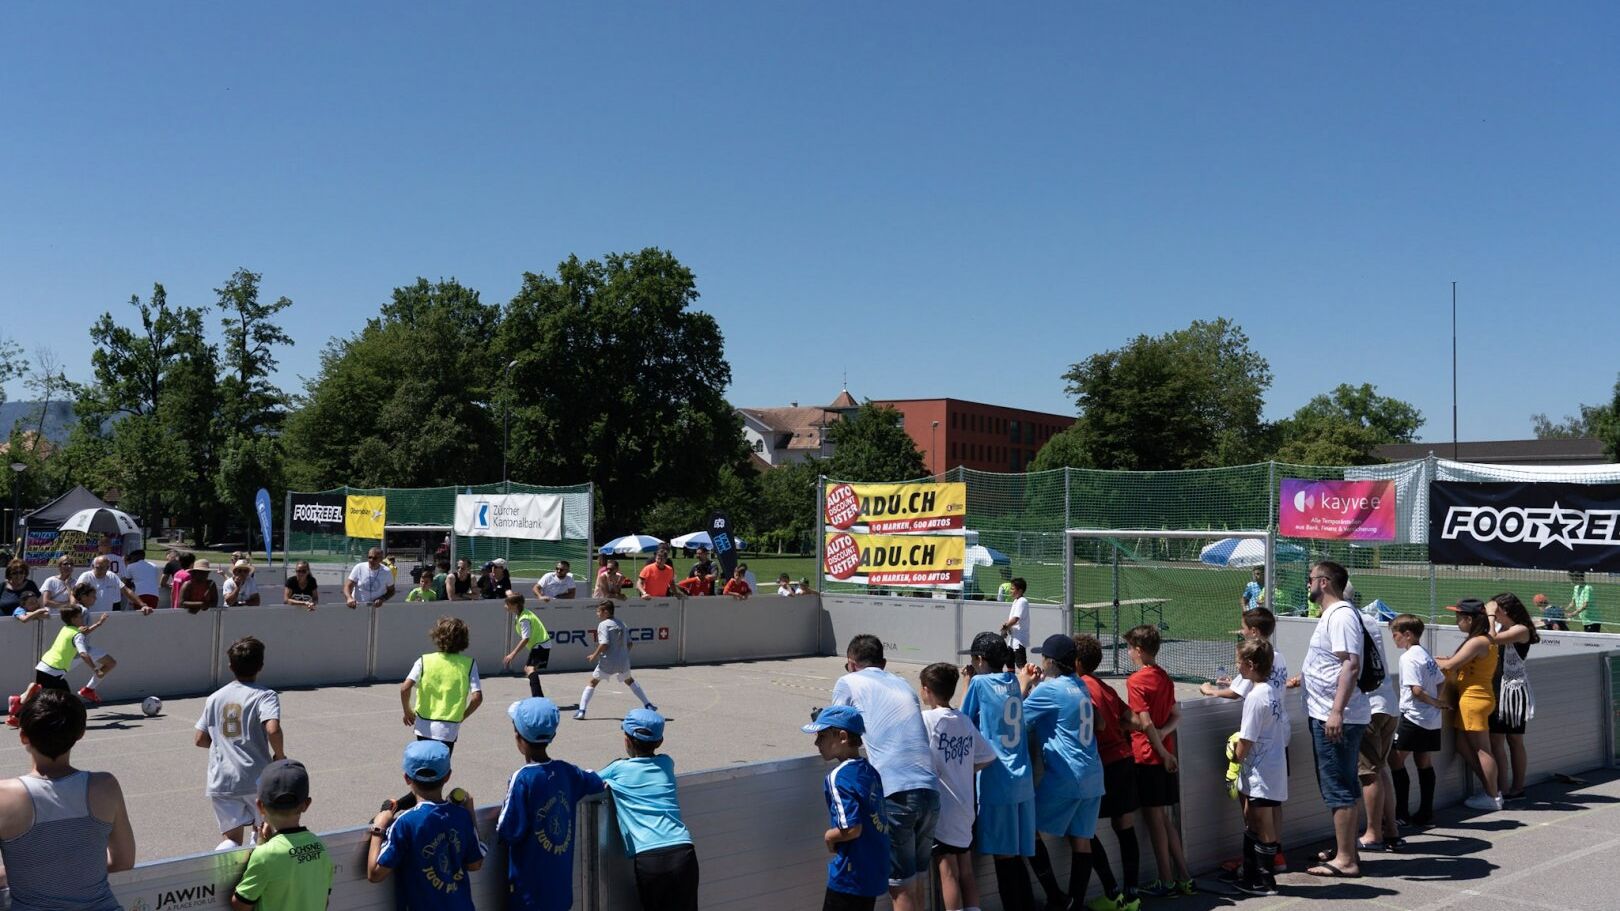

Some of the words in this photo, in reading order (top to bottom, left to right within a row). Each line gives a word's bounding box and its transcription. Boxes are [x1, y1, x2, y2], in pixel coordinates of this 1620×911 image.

[827, 485, 852, 508] AUTO
[829, 496, 856, 516] DISCOUNT
[859, 491, 936, 516] ADU.CH
[1321, 492, 1381, 514] kayvee
[493, 504, 520, 516] Zürcher
[830, 504, 858, 525] USTER
[913, 520, 927, 528] 600
[928, 518, 951, 528] AUTOS
[826, 536, 852, 557] AUTO
[828, 546, 856, 565] DISCOUNT
[859, 544, 936, 567] ADU.CH
[830, 554, 859, 575] USTER
[912, 572, 927, 581] 600
[927, 572, 950, 581] AUTOS
[223, 703, 242, 738] 8
[1000, 696, 1023, 748] 9
[1078, 697, 1094, 747] 8
[288, 842, 321, 857] OCHSNE
[298, 851, 321, 864] SPORT
[156, 884, 215, 910] JAWIN
